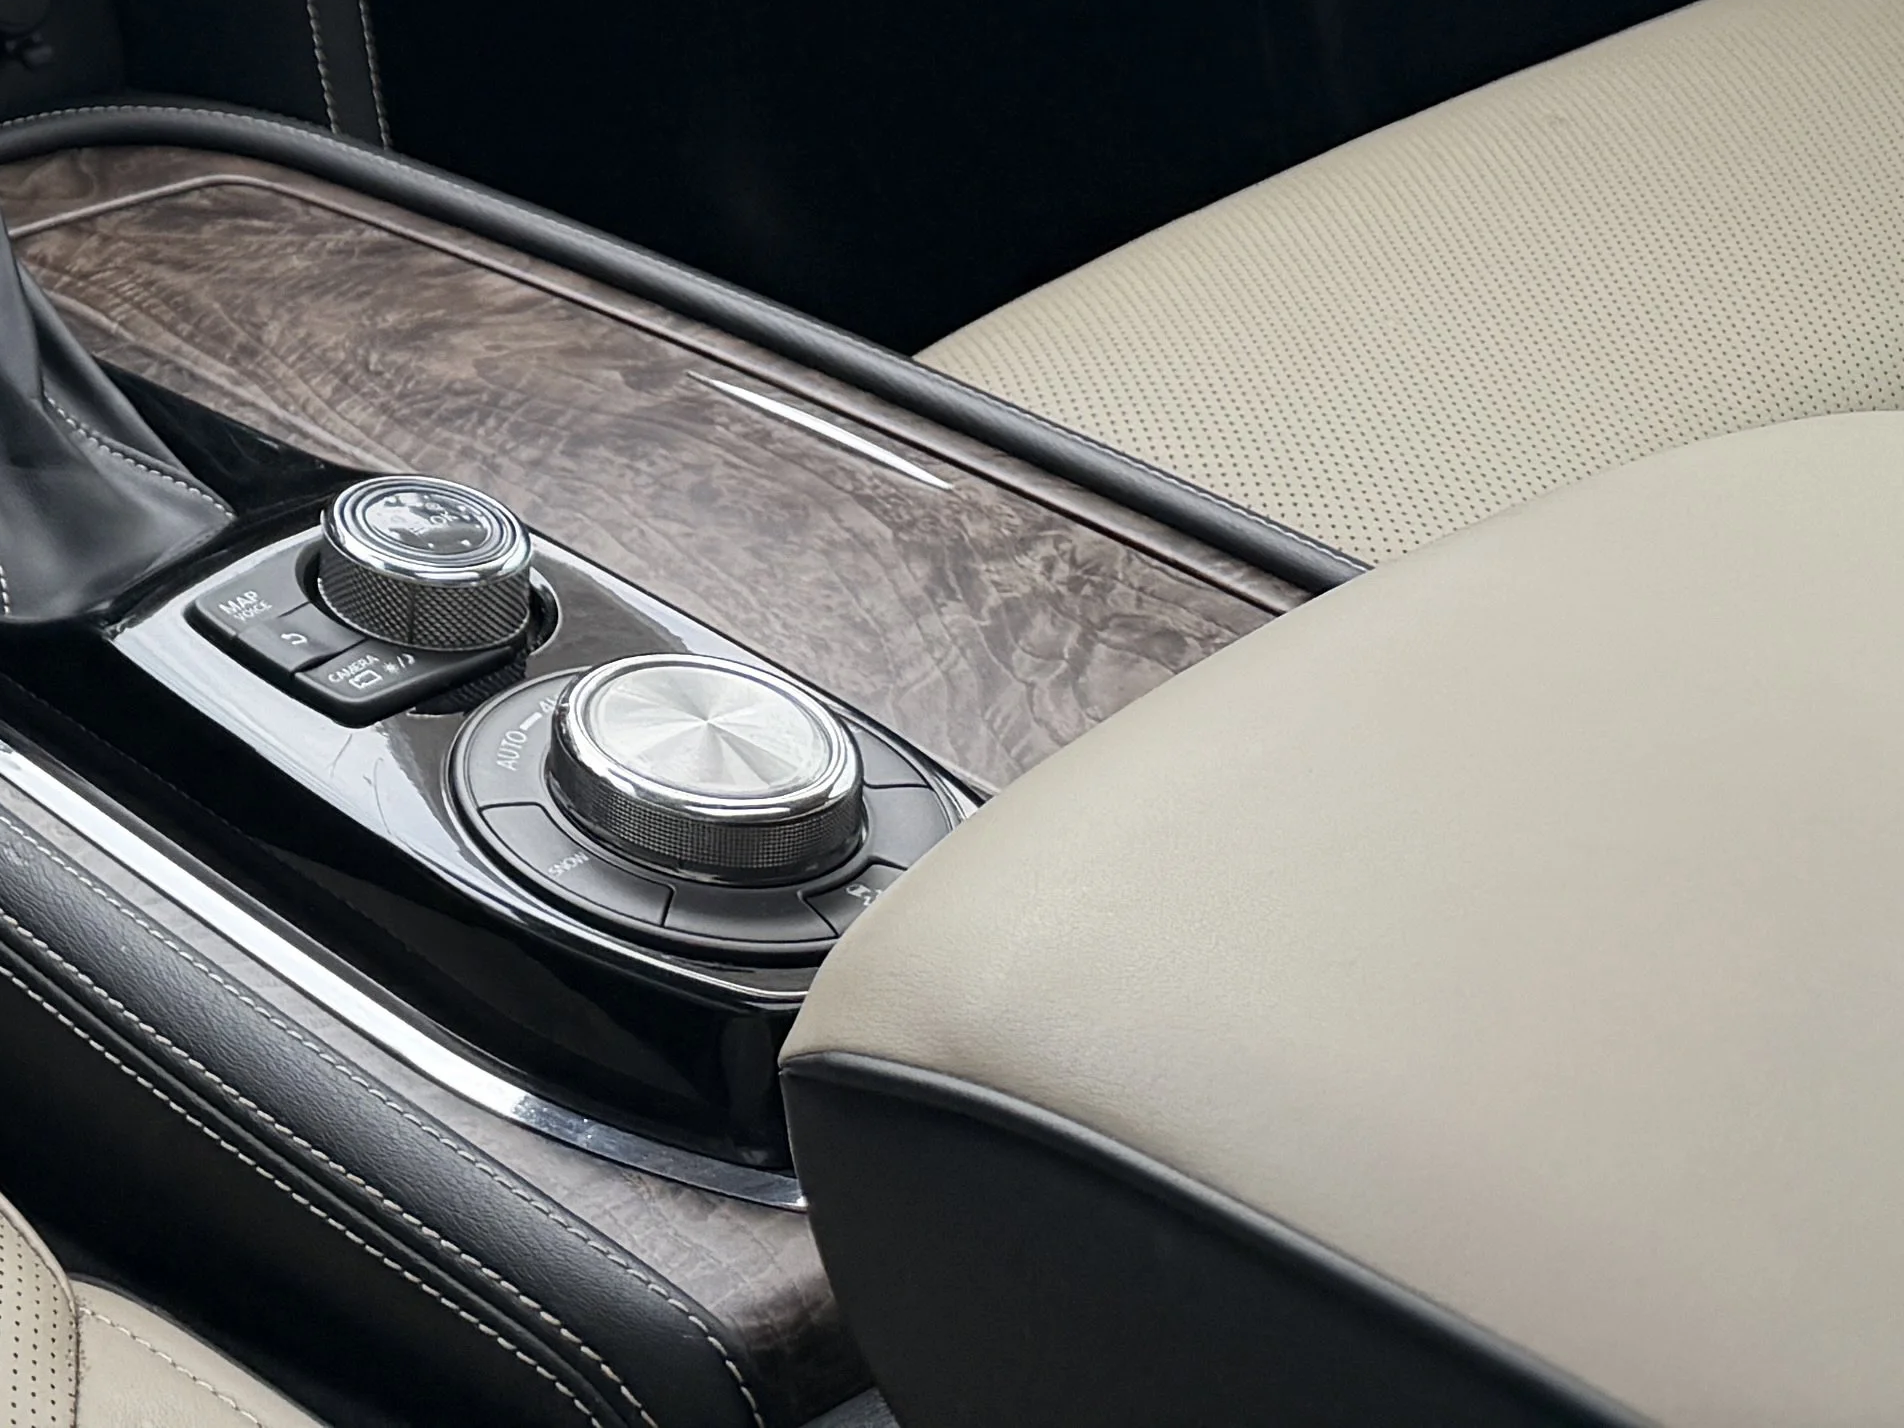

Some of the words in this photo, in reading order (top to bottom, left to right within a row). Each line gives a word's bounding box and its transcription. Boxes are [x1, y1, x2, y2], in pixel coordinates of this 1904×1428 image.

[218, 590, 258, 616] MAP
[328, 654, 380, 683] CAMERA
[496, 730, 528, 772] AUTO
[548, 851, 590, 877] SNOW
